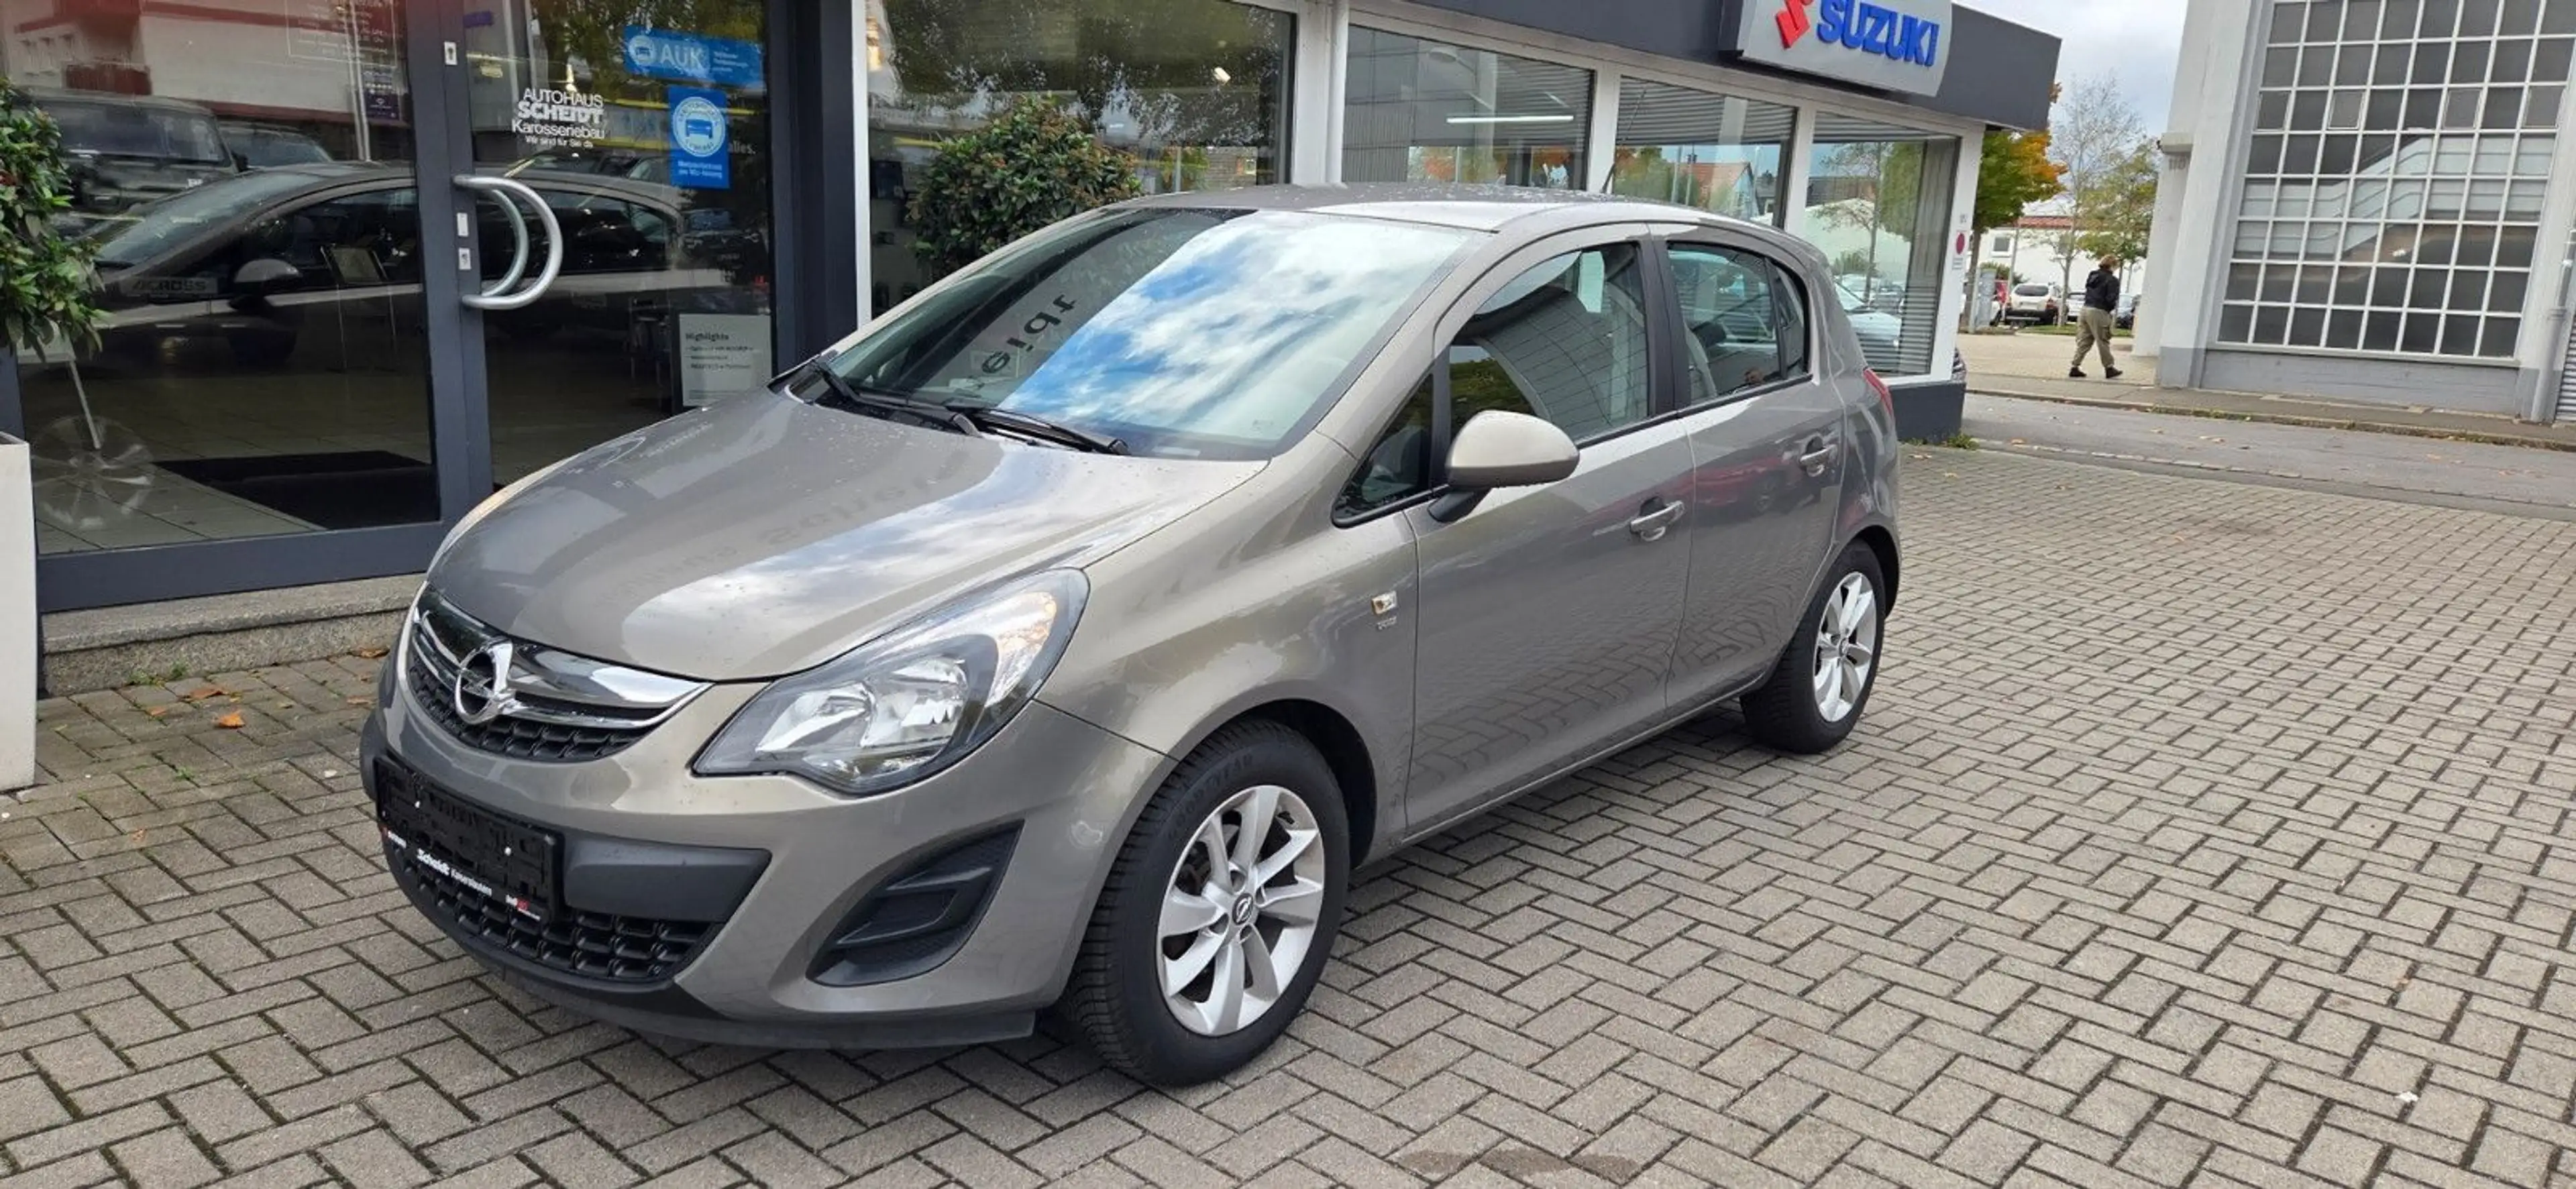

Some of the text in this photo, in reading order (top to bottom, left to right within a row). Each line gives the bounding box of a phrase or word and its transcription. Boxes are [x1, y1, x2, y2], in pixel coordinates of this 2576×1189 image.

[1817, 0, 1939, 67] SUZUKI
[523, 88, 604, 108] AUTOHAUS
[517, 101, 604, 123] SCHEIDT
[511, 119, 605, 139] Karosseriebau
